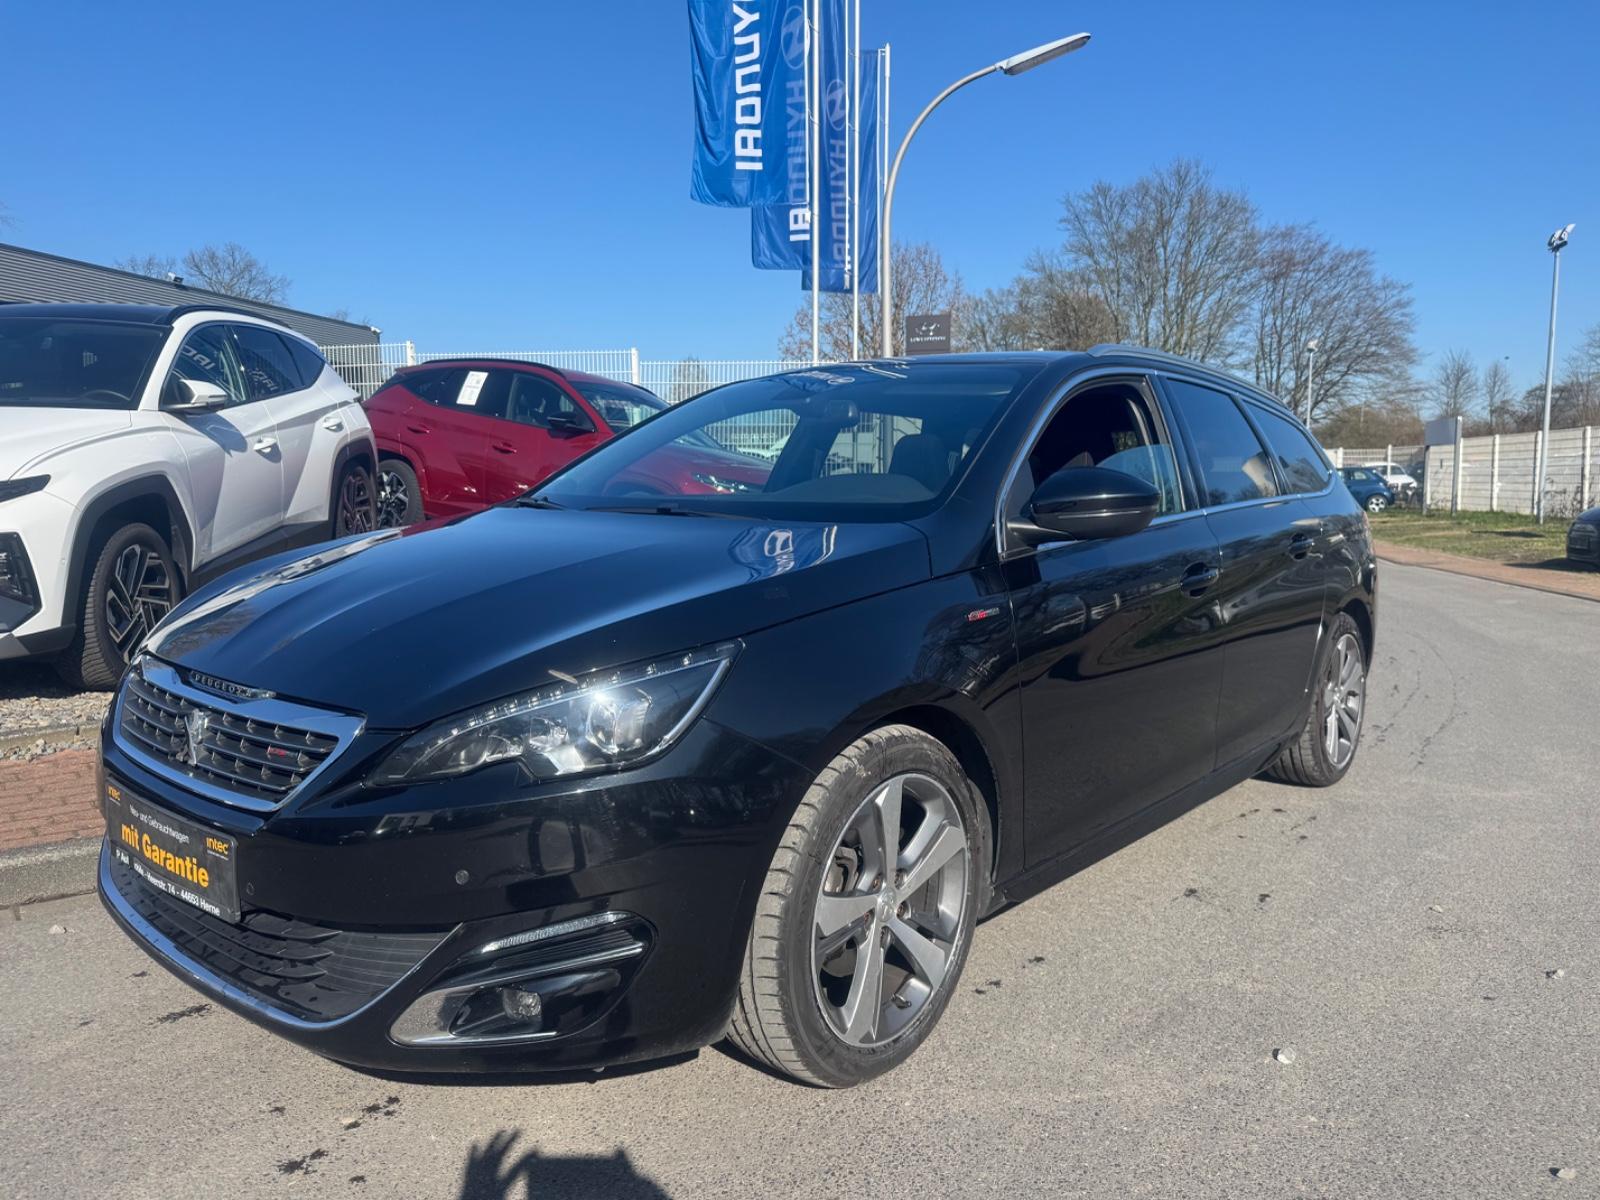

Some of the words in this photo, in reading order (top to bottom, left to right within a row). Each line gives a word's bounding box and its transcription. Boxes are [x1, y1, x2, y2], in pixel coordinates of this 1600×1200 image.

[121, 823, 140, 852] mit
[142, 833, 209, 888] Garantie
[200, 897, 220, 916] Herne
